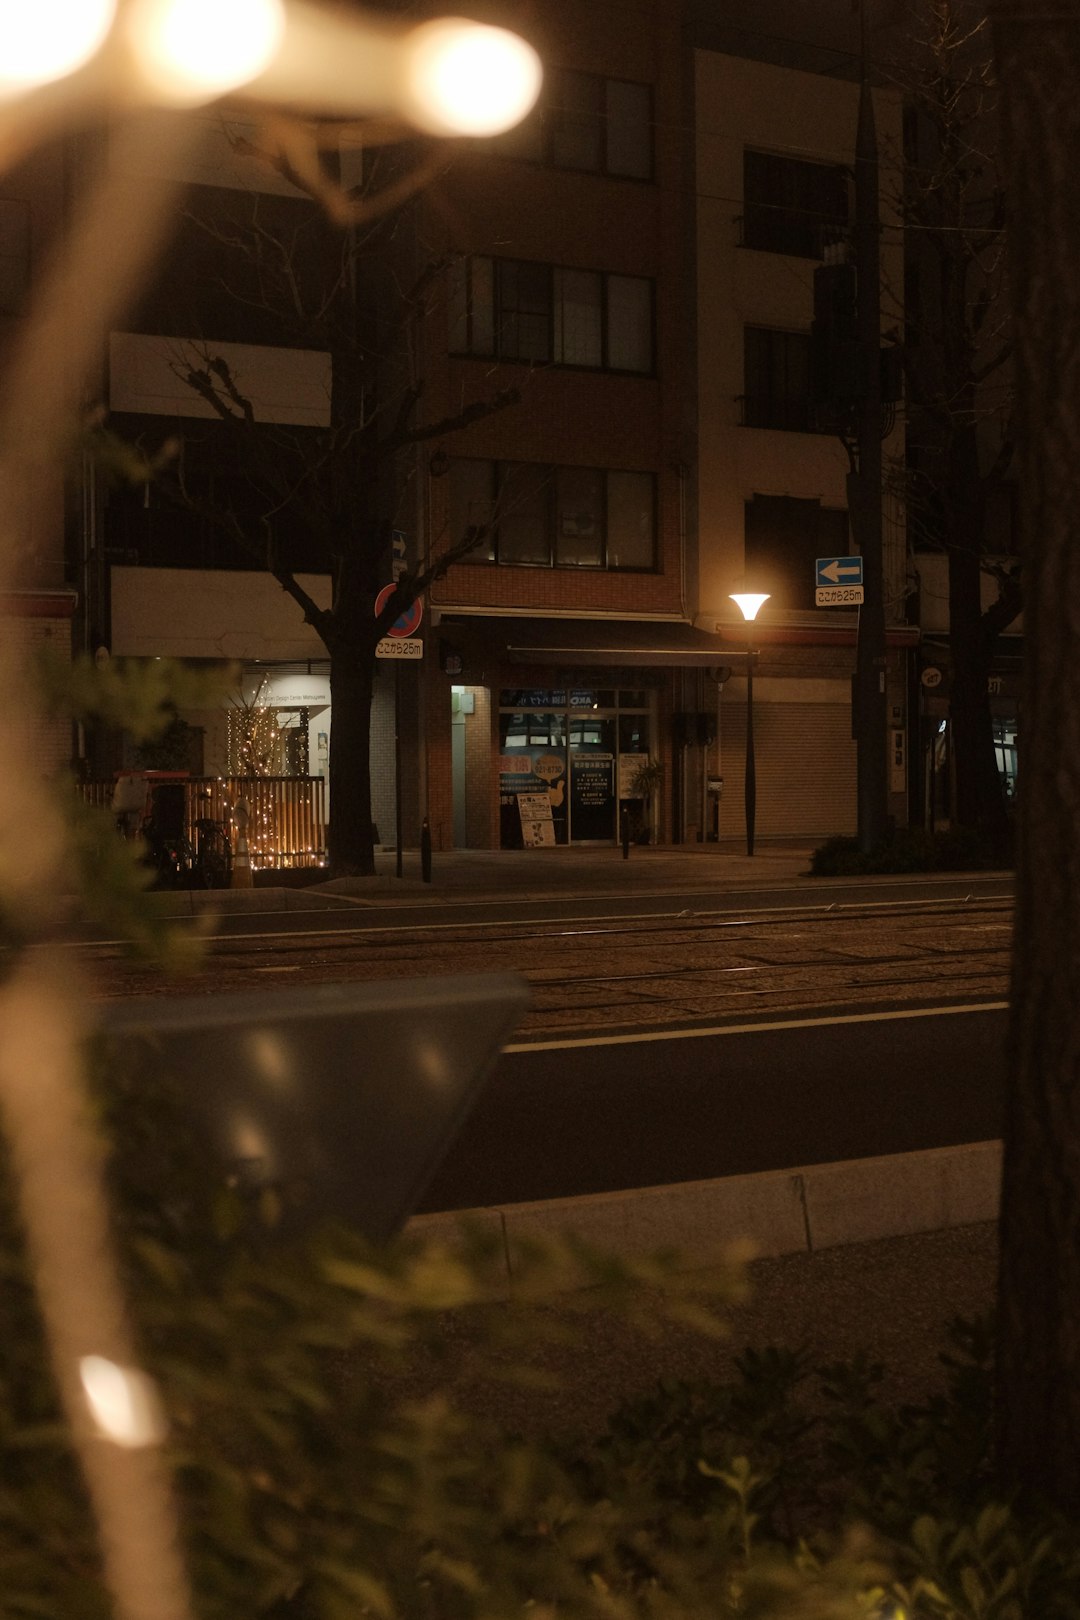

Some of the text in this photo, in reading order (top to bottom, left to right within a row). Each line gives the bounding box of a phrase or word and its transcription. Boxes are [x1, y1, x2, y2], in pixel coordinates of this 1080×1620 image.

[818, 589, 862, 603] ここから25m
[377, 642, 421, 656] ここから25m
